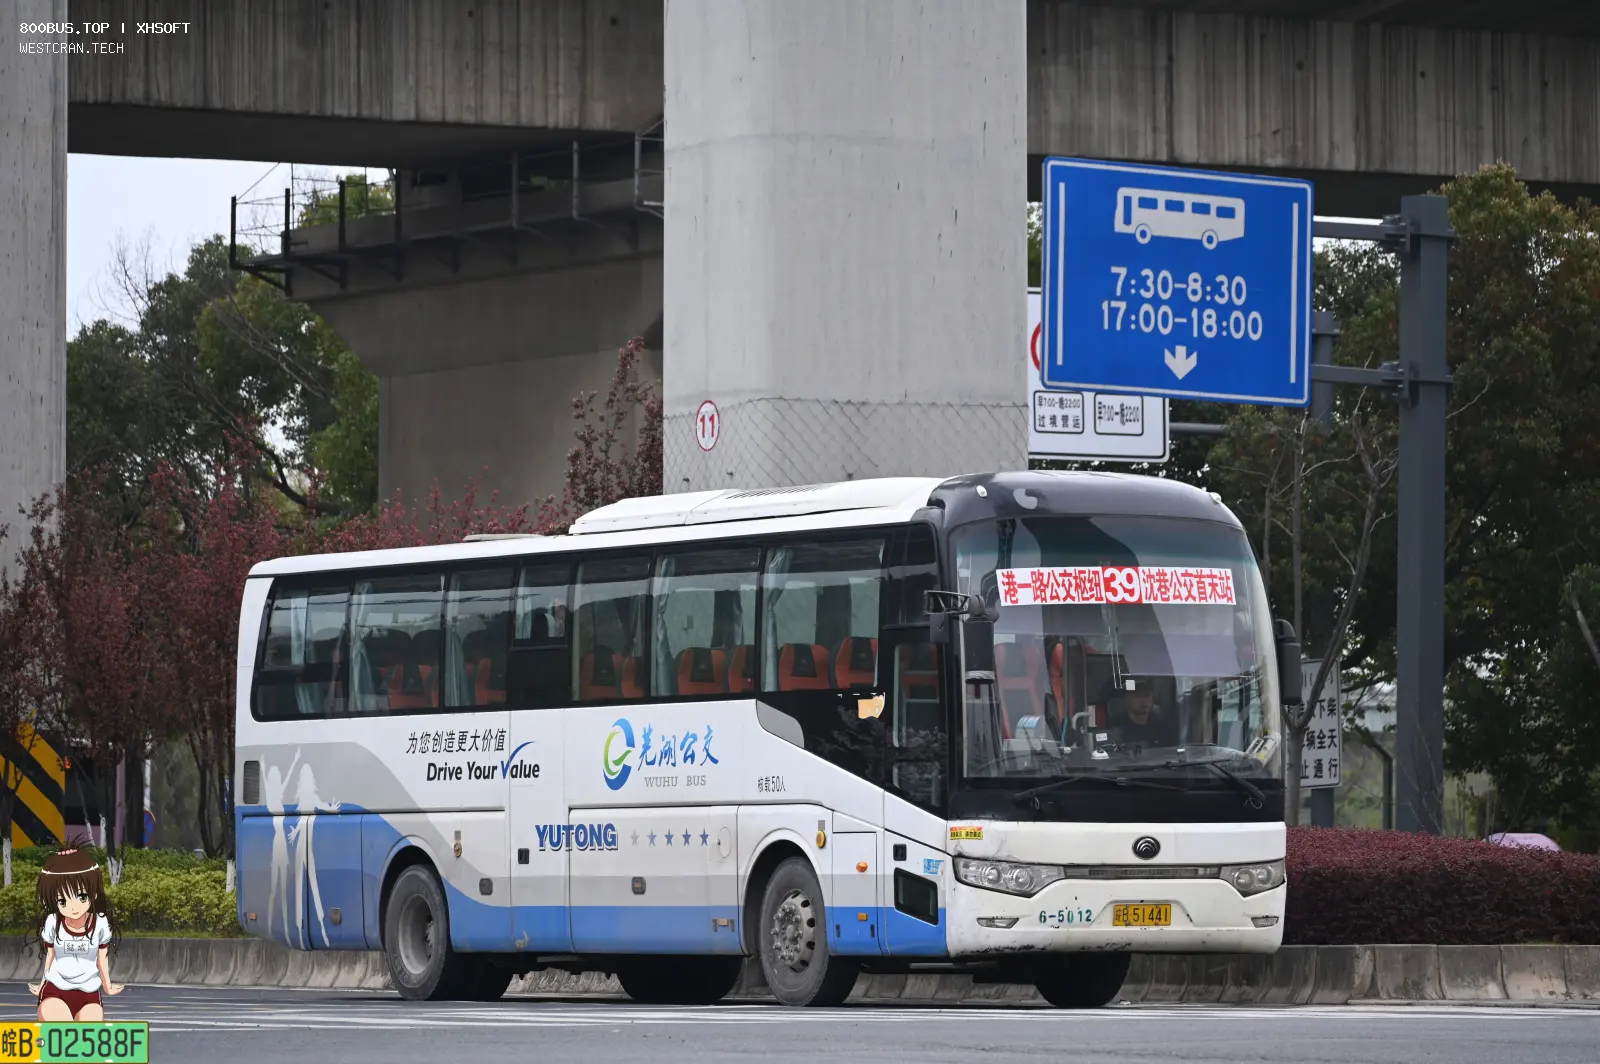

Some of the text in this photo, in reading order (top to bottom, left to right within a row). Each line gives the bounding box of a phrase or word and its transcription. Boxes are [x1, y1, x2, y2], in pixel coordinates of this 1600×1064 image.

[1110, 266, 1247, 306] 7:30-8:30
[1102, 300, 1263, 341] 17:00-18:00
[700, 414, 715, 438] 11
[1038, 414, 1080, 429] 过境营运
[1001, 567, 1234, 604] 港一路公交枢纽 39 沈巷公交首末站
[406, 728, 507, 754] 为您创造更大价值
[638, 723, 719, 771] 芜湖公交
[427, 748, 540, 781] Drive Your Value
[1288, 757, 1339, 780] 止通行
[644, 775, 707, 788] WUHU BUS
[757, 775, 786, 793] 核载50人
[535, 823, 619, 852] YUTONG
[1039, 909, 1092, 923] 6-5012
